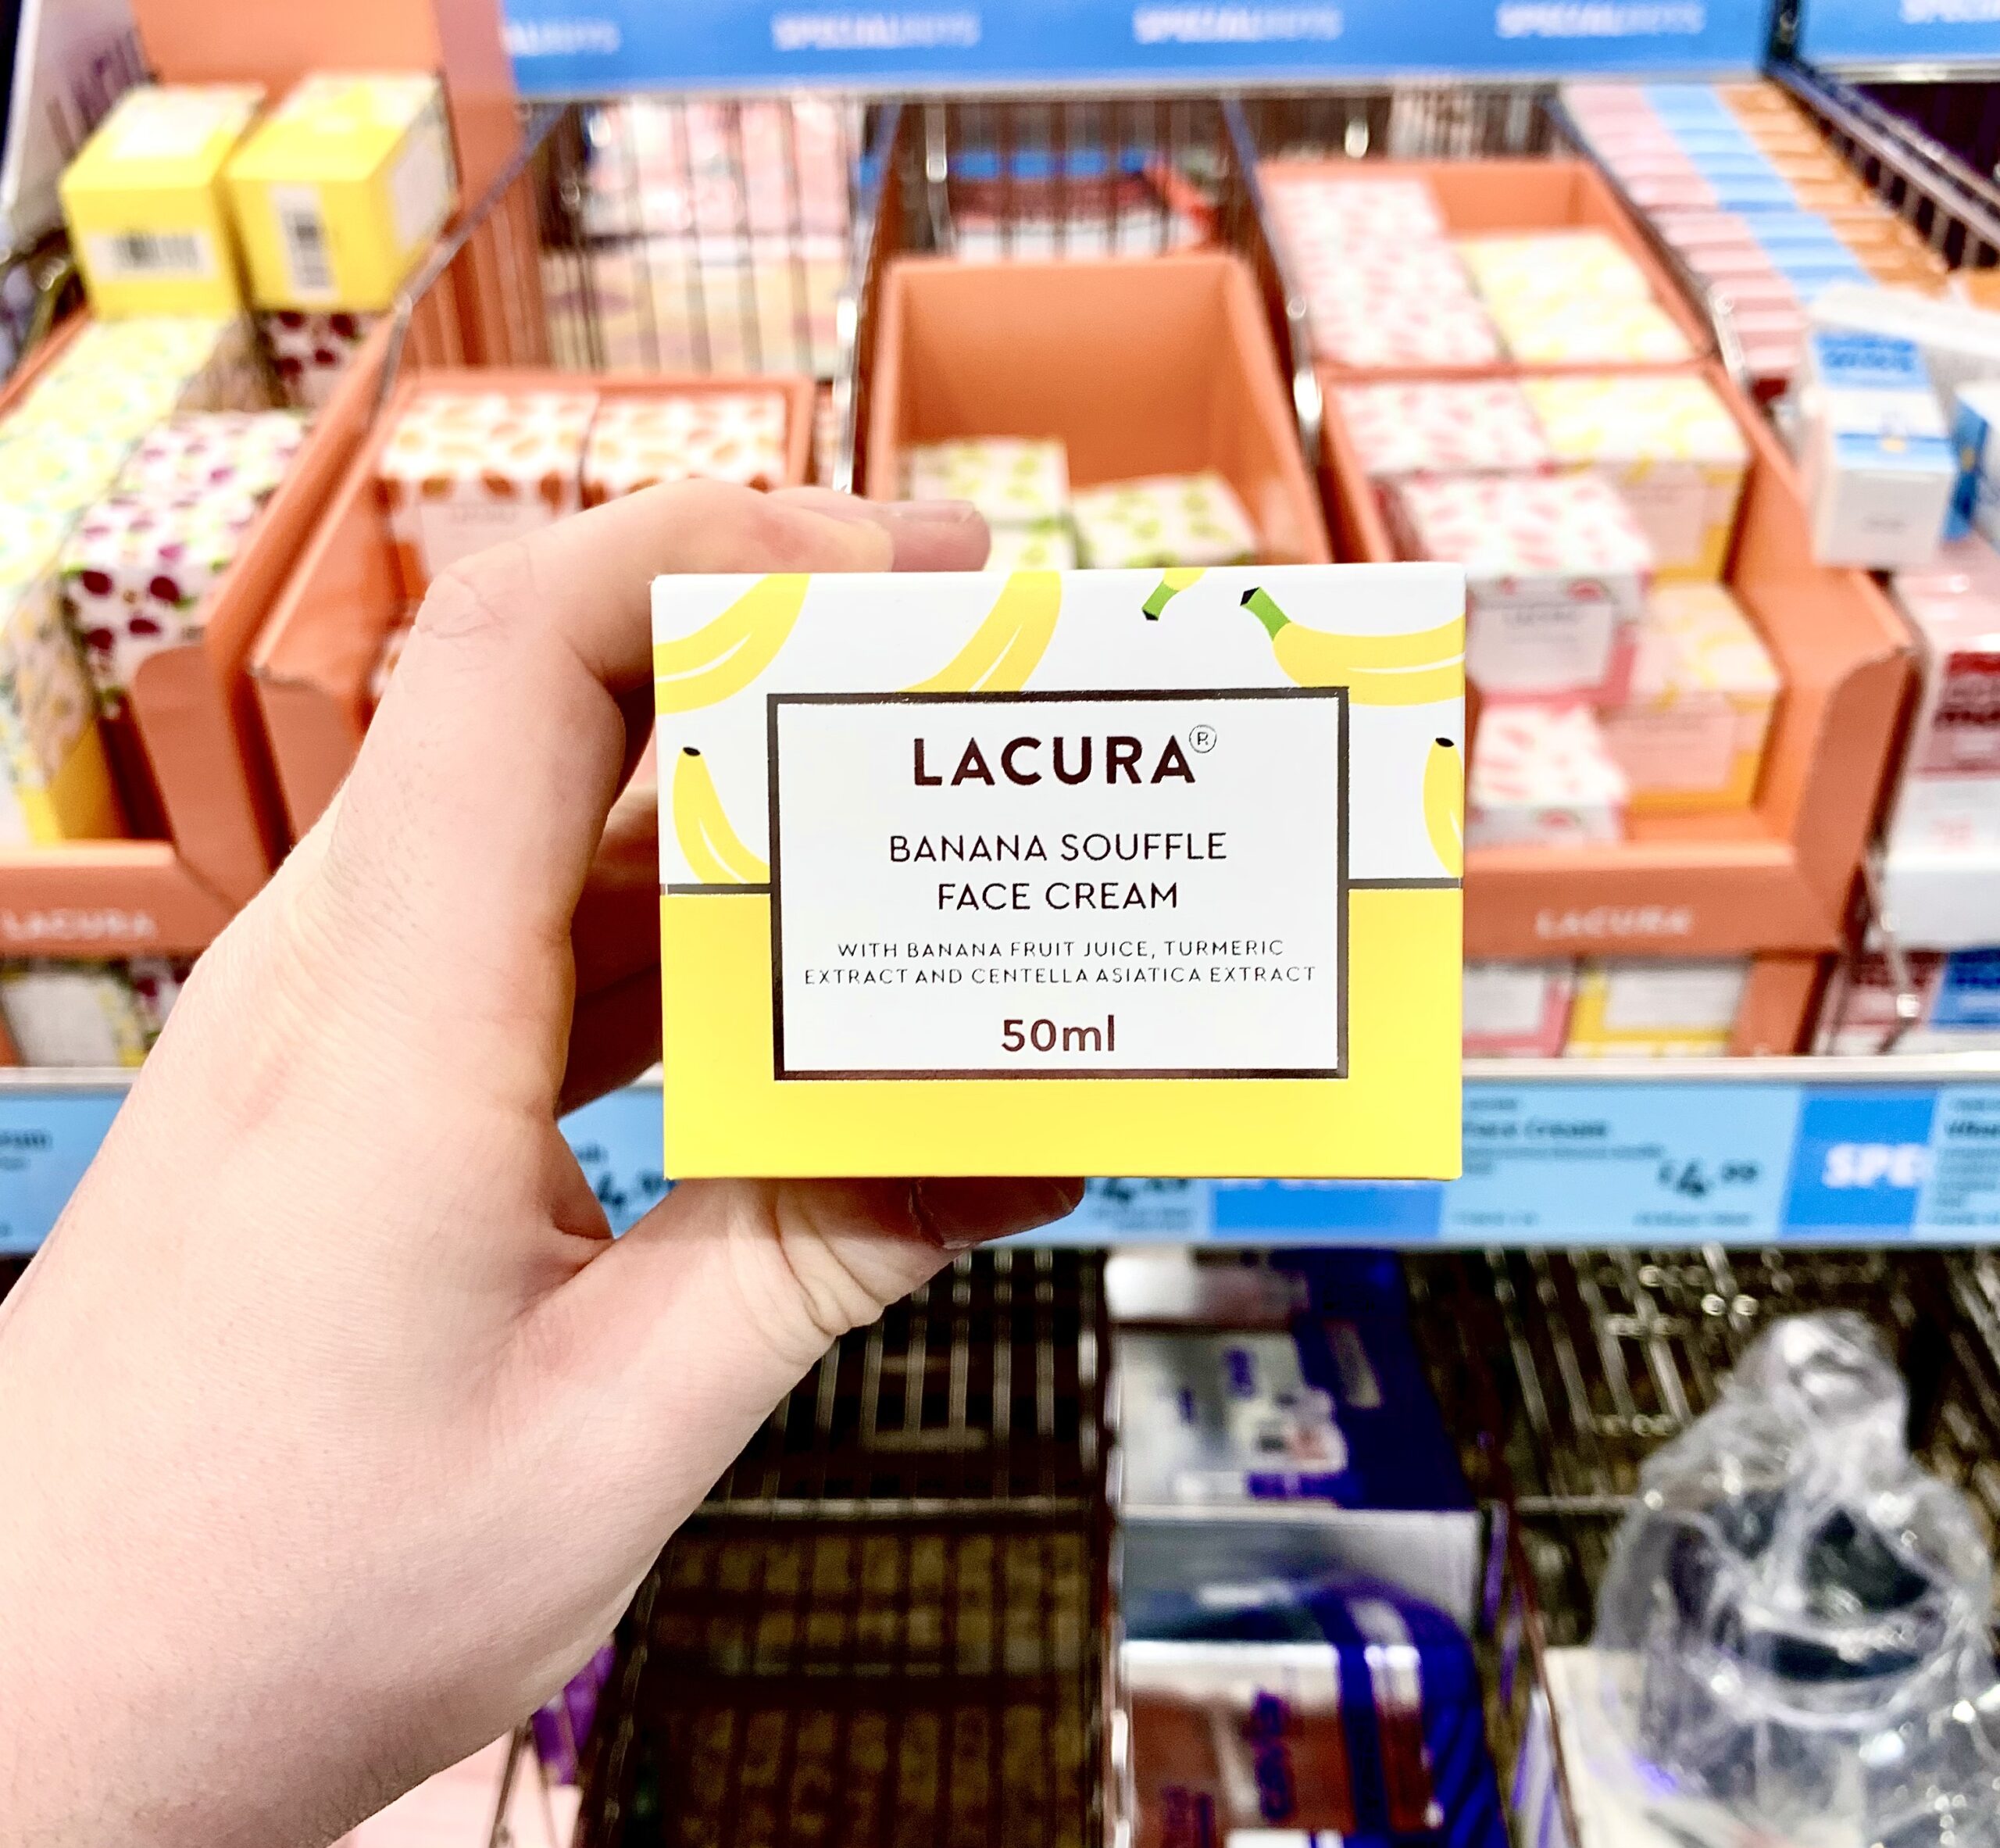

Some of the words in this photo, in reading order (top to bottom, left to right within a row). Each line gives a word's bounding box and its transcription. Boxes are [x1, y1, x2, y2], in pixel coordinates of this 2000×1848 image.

[890, 834, 1048, 863] BANANA
[1060, 831, 1227, 862] SOUFFLE
[938, 882, 1031, 911] FACE
[1045, 881, 1177, 910] CREAM
[838, 942, 898, 959] WITH
[907, 942, 1003, 958] BANANA
[1010, 941, 1074, 958] FRUIT
[1083, 941, 1155, 960] JUICE,
[1163, 939, 1284, 957] TURMERIC
[805, 968, 908, 985] EXTRACT
[915, 968, 963, 985] AND
[971, 967, 1088, 985] CENTELLA
[1095, 967, 1202, 985] ASIATICA
[1210, 967, 1316, 983] EXTRACT
[1001, 1013, 1116, 1053] 50ml
